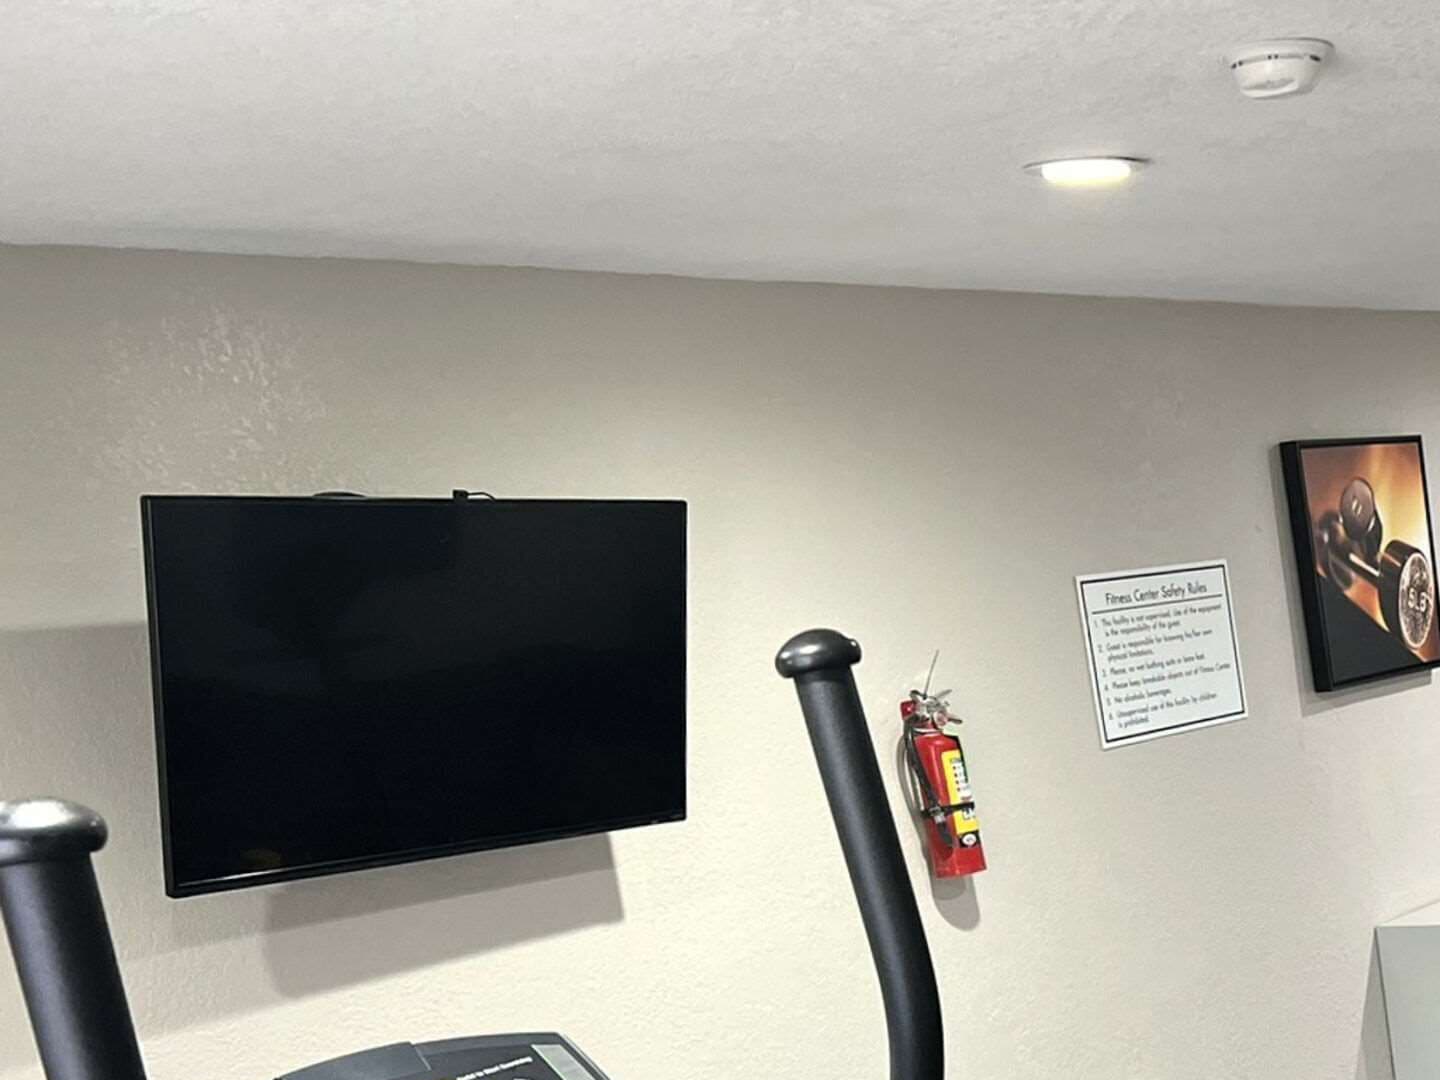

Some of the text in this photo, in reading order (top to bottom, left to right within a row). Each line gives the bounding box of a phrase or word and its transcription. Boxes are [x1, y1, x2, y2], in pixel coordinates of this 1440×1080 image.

[1105, 580, 1207, 605] Fitness Center Safety Rules
